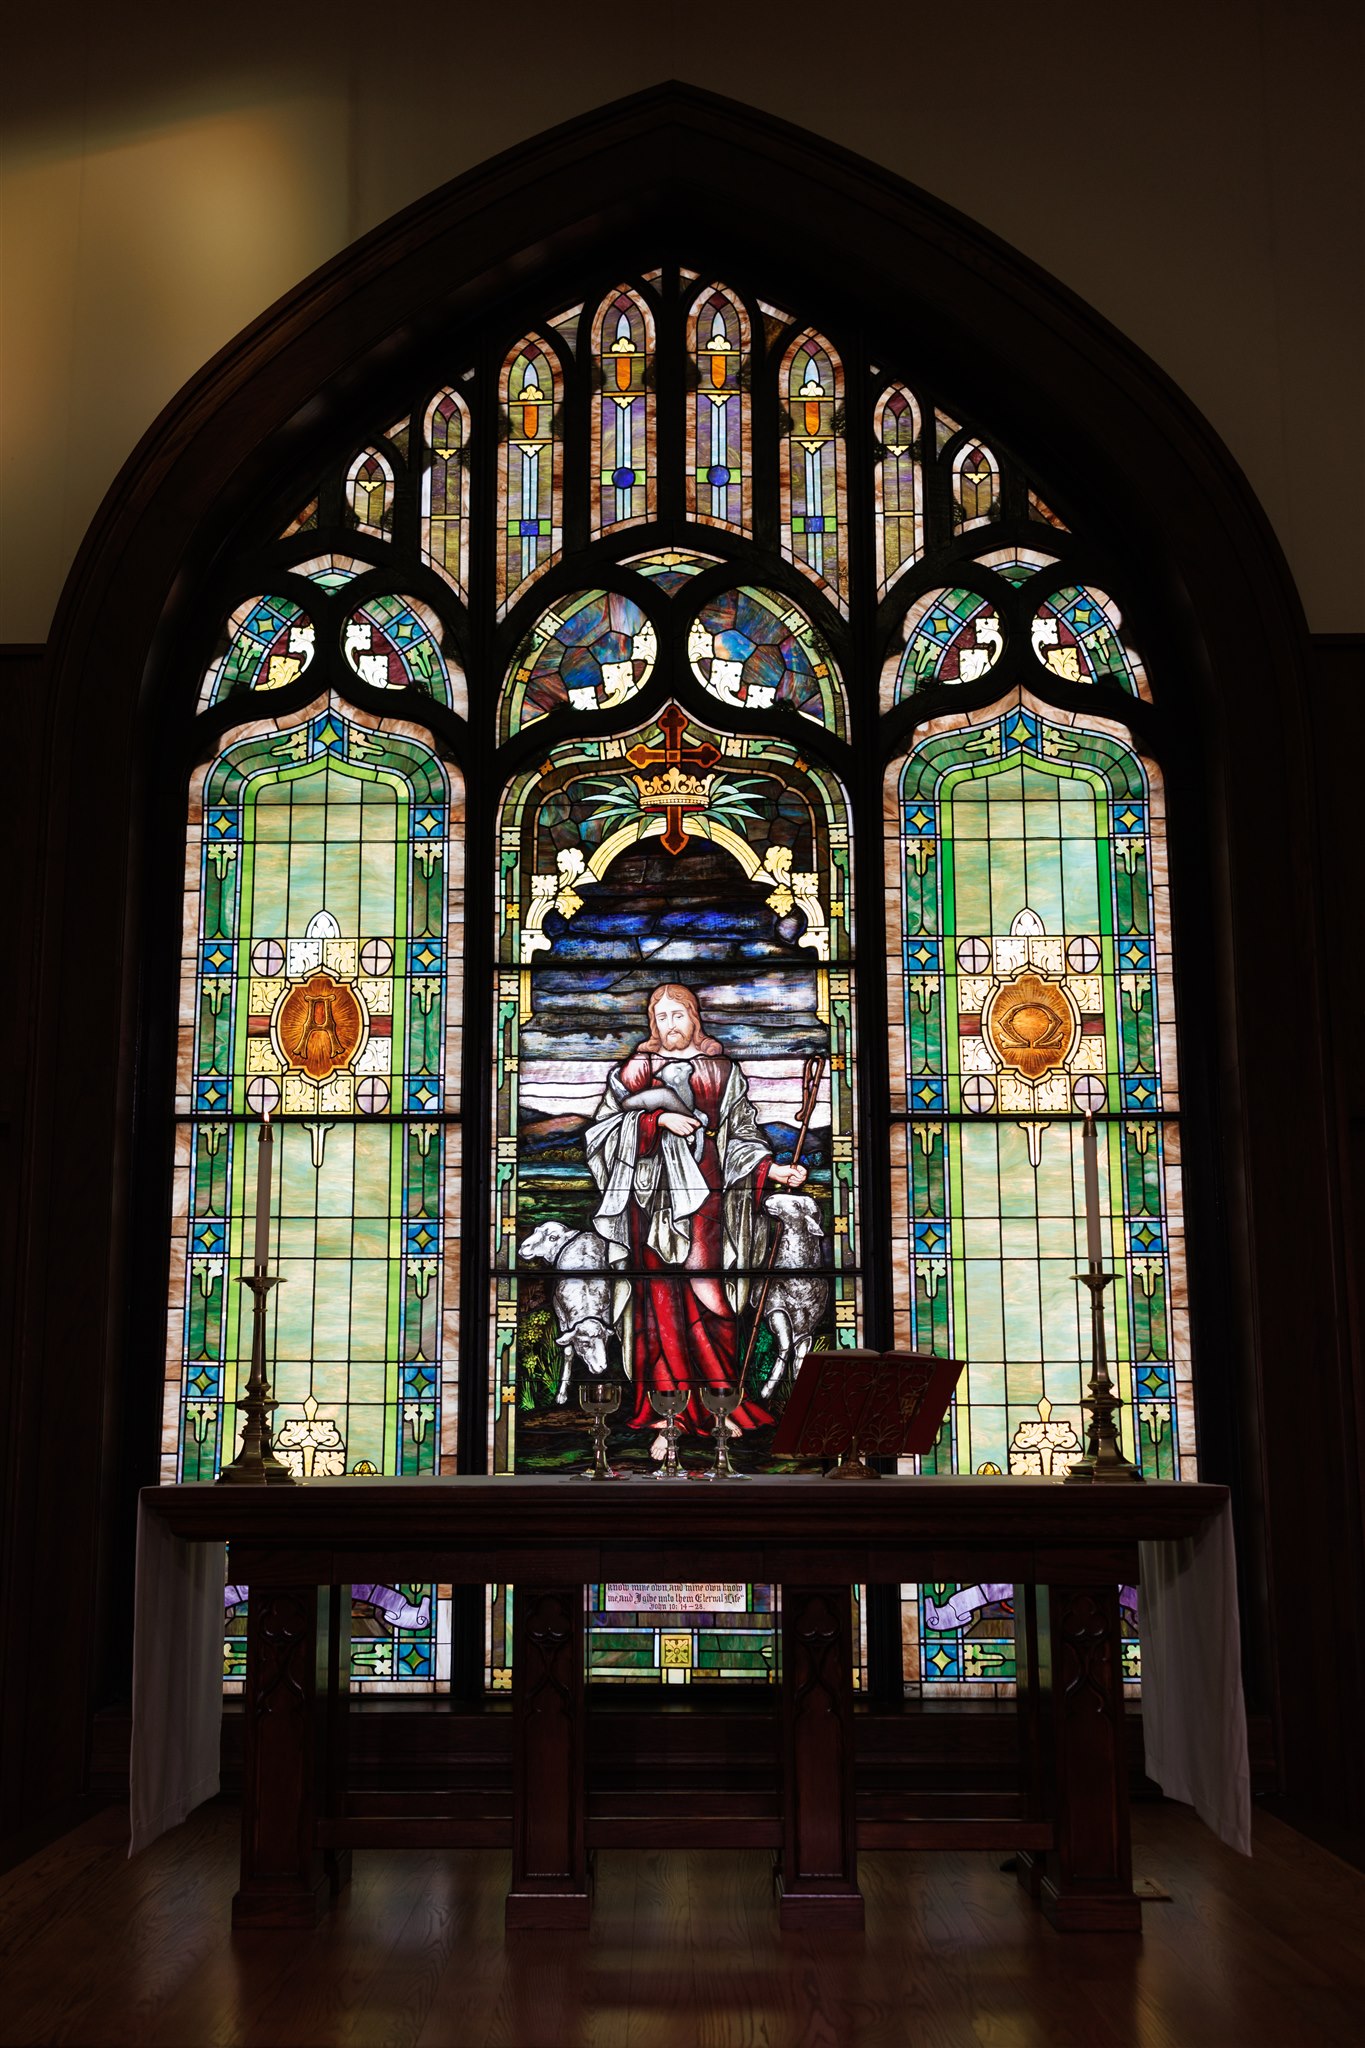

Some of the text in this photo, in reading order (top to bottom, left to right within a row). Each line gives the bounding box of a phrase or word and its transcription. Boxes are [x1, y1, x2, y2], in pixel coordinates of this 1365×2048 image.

[607, 1583, 630, 1592] know
[631, 1584, 650, 1592] mine
[669, 1584, 683, 1592] and
[685, 1584, 704, 1592] mine
[705, 1583, 721, 1592] own
[722, 1583, 743, 1592] know
[619, 1594, 633, 1602] and
[642, 1594, 657, 1604] give
[658, 1594, 674, 1602] unto
[675, 1593, 694, 1604] them
[694, 1593, 724, 1603] Eternal
